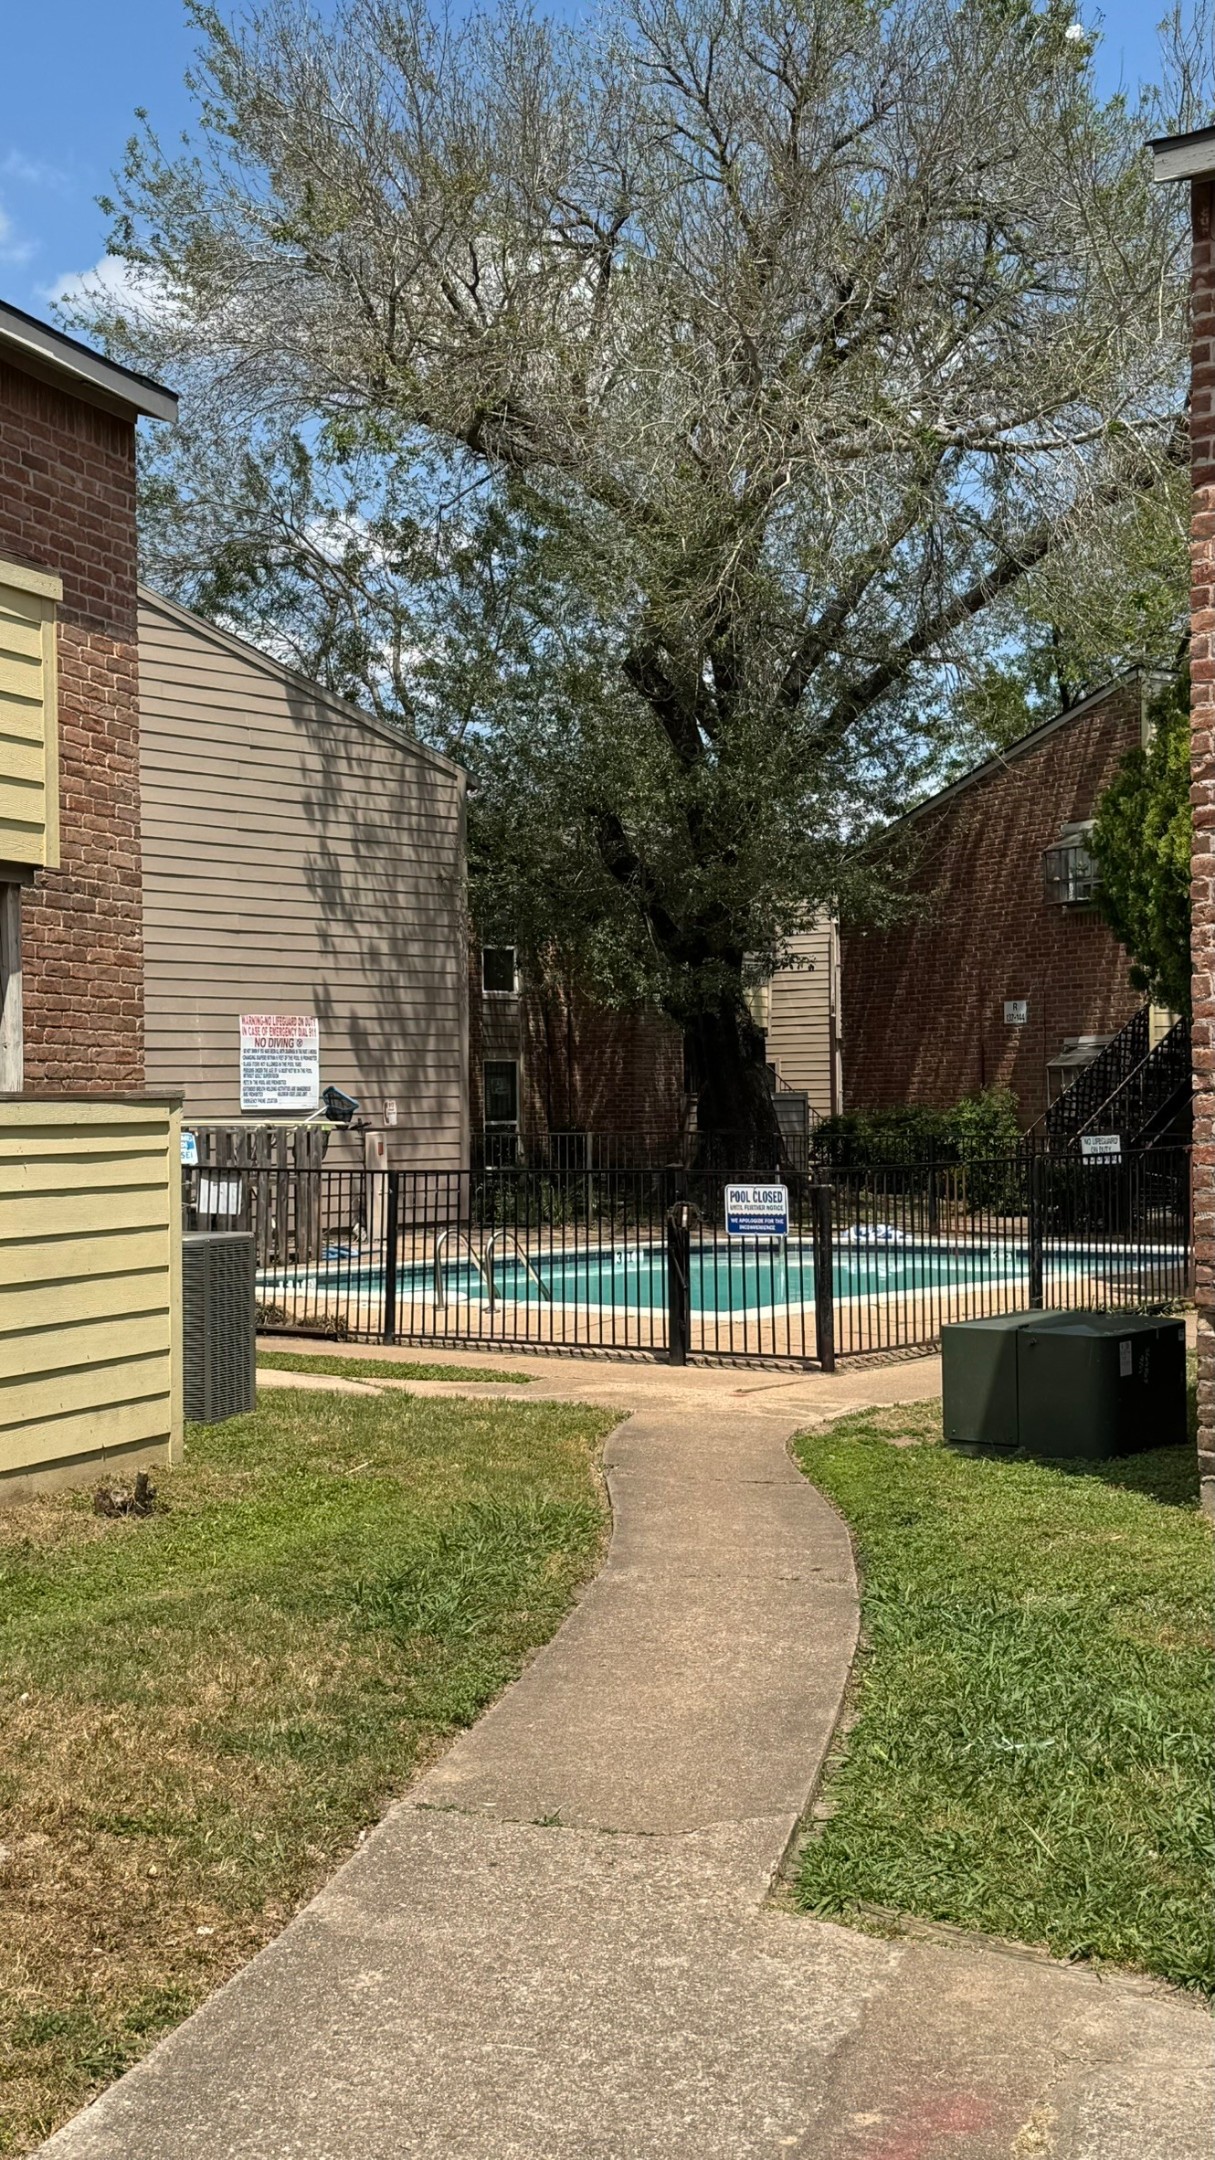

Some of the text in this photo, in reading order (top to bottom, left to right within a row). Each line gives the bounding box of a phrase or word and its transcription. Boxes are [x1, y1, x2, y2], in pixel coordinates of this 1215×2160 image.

[1013, 1002, 1017, 1011] R
[272, 1016, 297, 1026] LIFEGUARD
[298, 1017, 304, 1026] ON
[305, 1017, 316, 1026] DUTY
[242, 1026, 247, 1036] IN
[248, 1027, 260, 1036] CASE
[261, 1027, 268, 1036] OF
[269, 1027, 297, 1037] EMERGENCY
[298, 1028, 308, 1037] DIAL
[254, 1037, 294, 1048] NO DIVING
[1092, 1137, 1118, 1145] LIFEGUARD
[730, 1191, 782, 1203] POOL CLOSED
